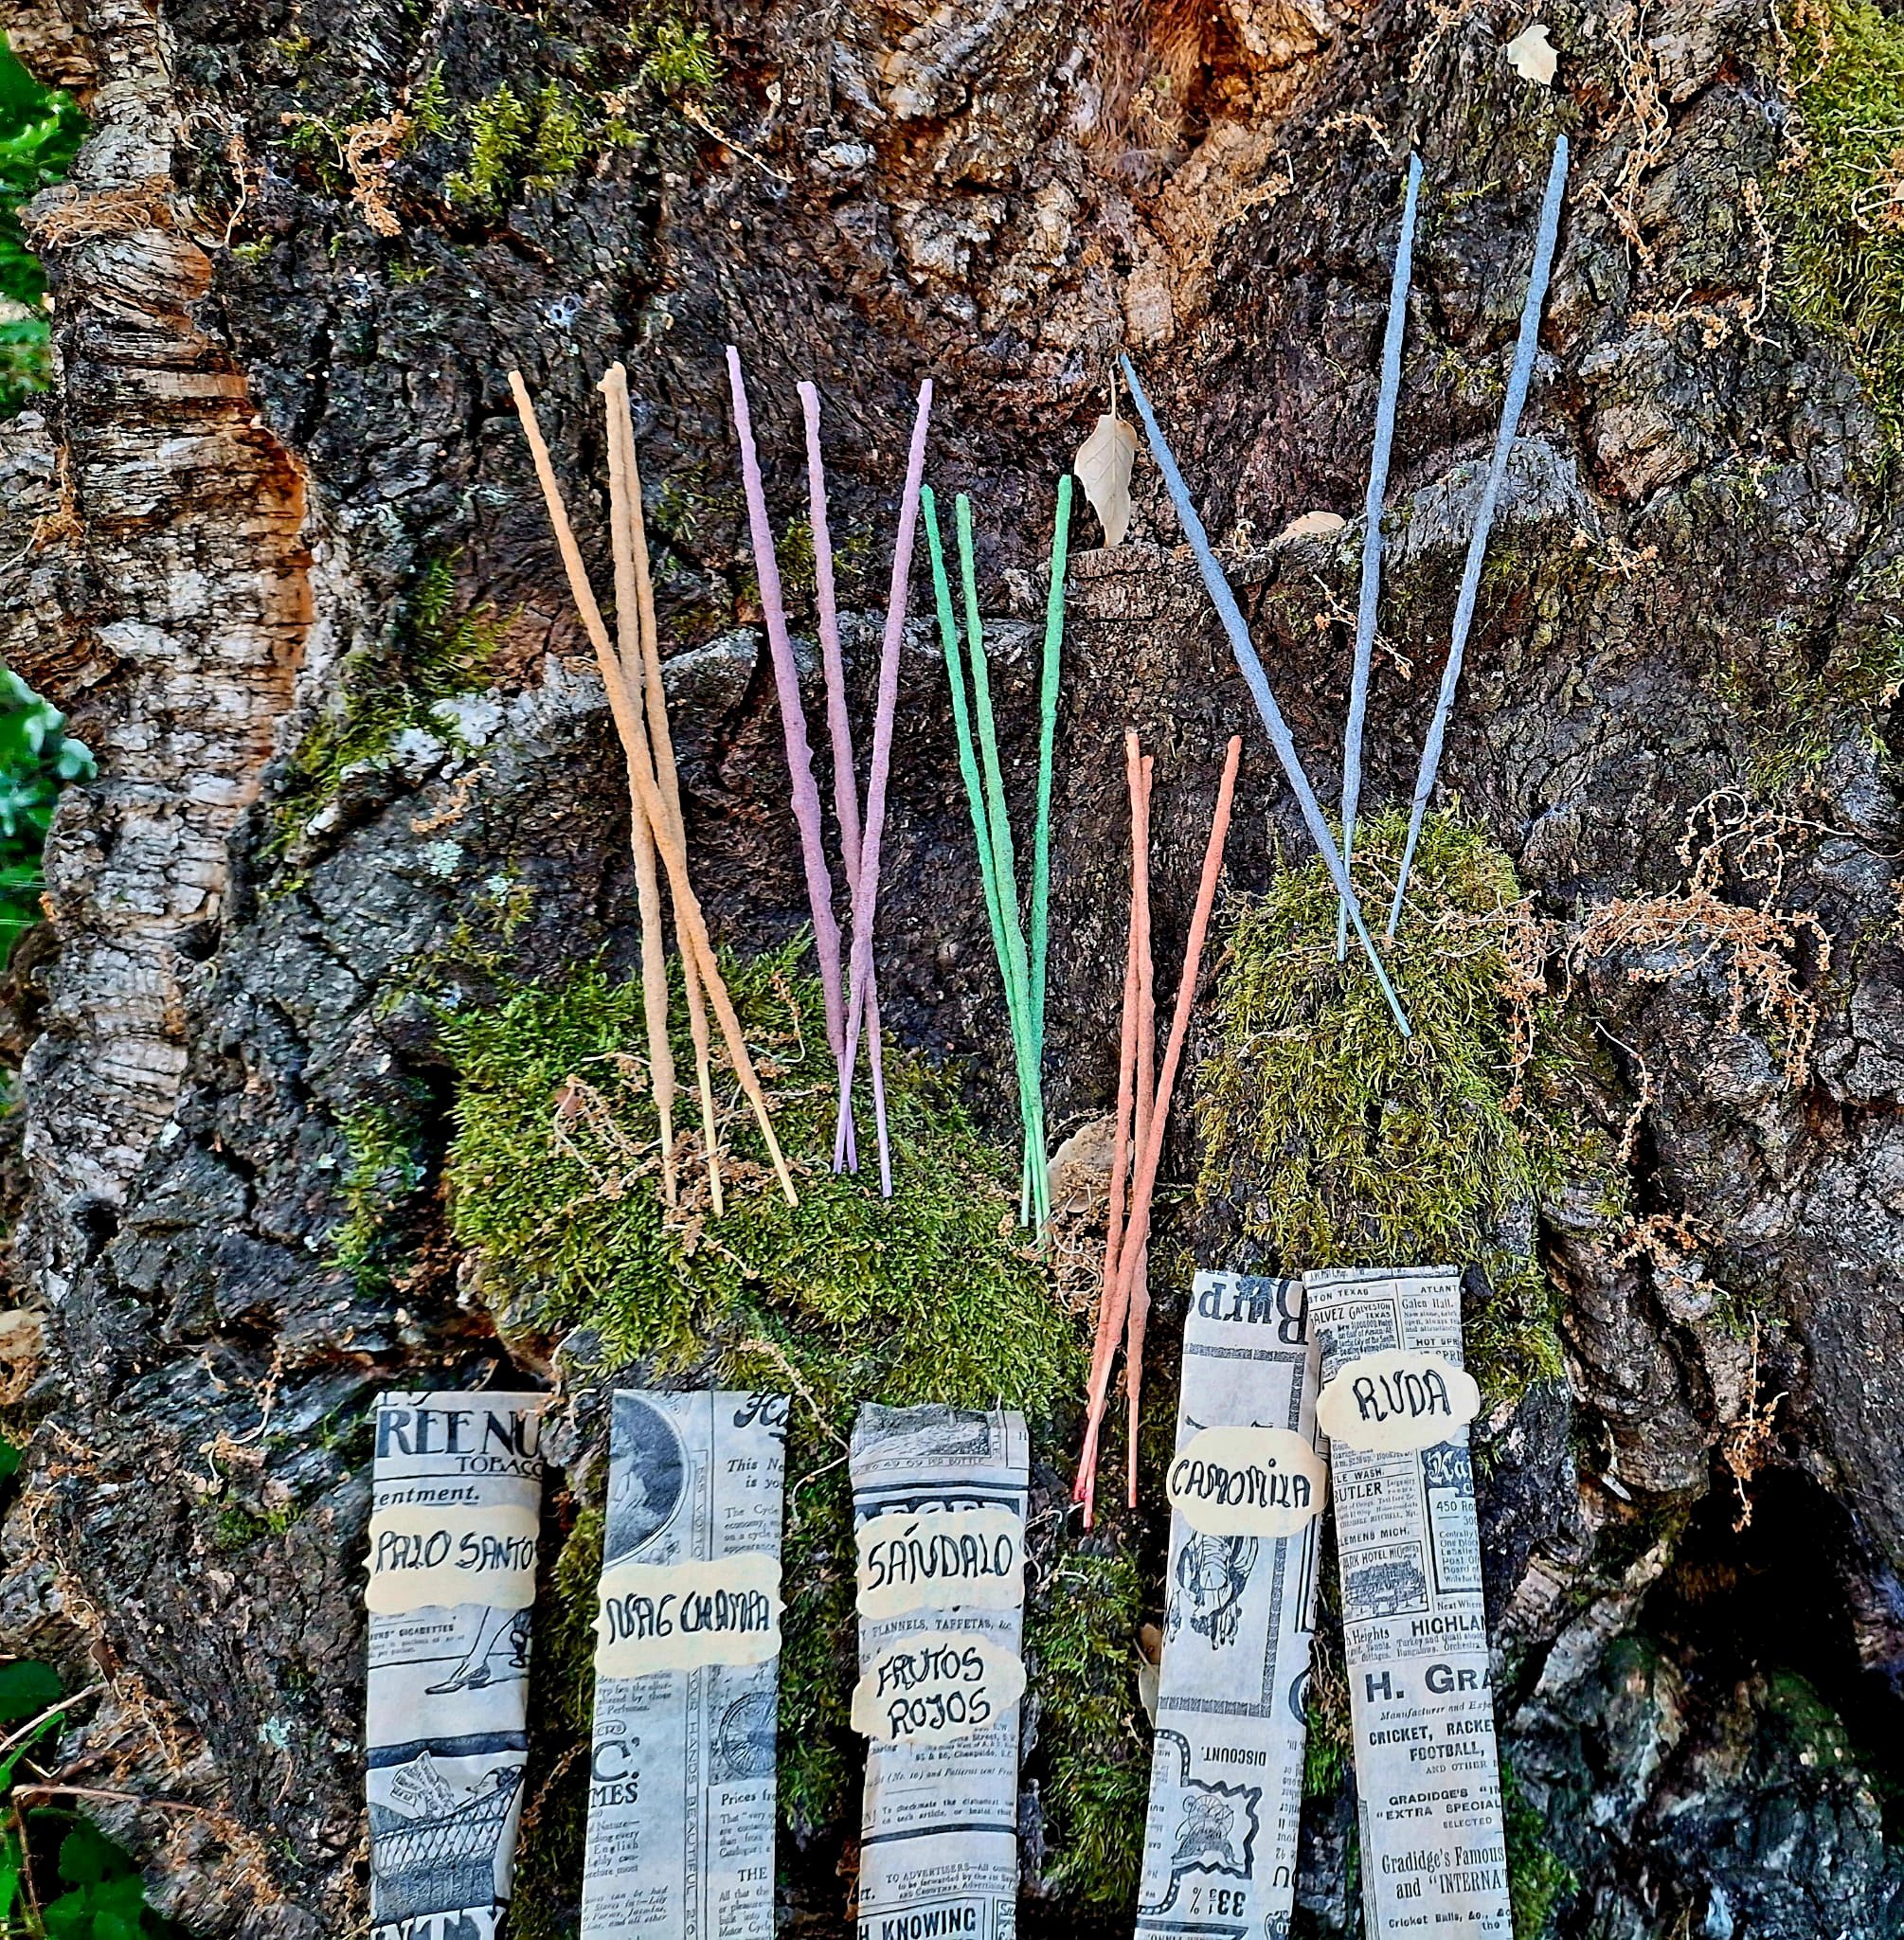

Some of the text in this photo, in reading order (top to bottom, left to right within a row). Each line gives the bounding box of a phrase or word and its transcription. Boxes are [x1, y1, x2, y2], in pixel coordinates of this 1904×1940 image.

[1338, 1288, 1369, 1297] TEXAS
[1349, 1302, 1391, 1320] GALVESTON
[1353, 1370, 1452, 1421] RUDA
[727, 1458, 758, 1473] This
[1355, 1467, 1385, 1480] WASH.
[745, 1475, 758, 1488] is
[373, 1485, 479, 1506] entment.
[1335, 1482, 1382, 1503] BUTLER
[1436, 1501, 1457, 1512] 450
[1381, 1527, 1410, 1538] MICH.
[376, 1530, 534, 1573] PALO SANTO
[868, 1522, 1014, 1590] SÁNDALO
[1362, 1548, 1388, 1564] HOTEL
[606, 1589, 770, 1645] NAG CHAMPA
[872, 1619, 994, 1638] FLANNELS, TAFFETAS,
[1352, 1626, 1390, 1644] Heights
[876, 1644, 983, 1698] FRUTOS
[1366, 1671, 1404, 1702] H.
[888, 1687, 990, 1739] ROJOS
[1380, 1706, 1445, 1720] Manufacturer
[1448, 1703, 1464, 1712] and
[1369, 1726, 1433, 1746] CRICKET,
[688, 1722, 698, 1785] HANDS
[1201, 1746, 1266, 1767] DISCOUNT.
[1410, 1741, 1484, 1762] FOOTBALL,
[1426, 1760, 1487, 1774] AND OTHER
[722, 1792, 756, 1805] Prices
[1389, 1788, 1468, 1805] GRADIDGE'S
[1446, 1800, 1501, 1813] SPECIAL
[1443, 1817, 1493, 1828] SELECTED
[686, 1796, 698, 1895] BEAUTIFUL
[1382, 1846, 1504, 1874] Gradidge's Famous
[737, 1866, 767, 1882] THE
[887, 1875, 899, 1884] TO
[908, 1880, 917, 1889] be
[921, 1875, 959, 1887] forwarded
[962, 1874, 972, 1882] by
[974, 1872, 986, 1880] the
[1396, 1877, 1422, 1899] and
[882, 1908, 976, 1940] KNOWING
[1389, 1915, 1428, 1929] Cricket
[1482, 1921, 1500, 1931] the
